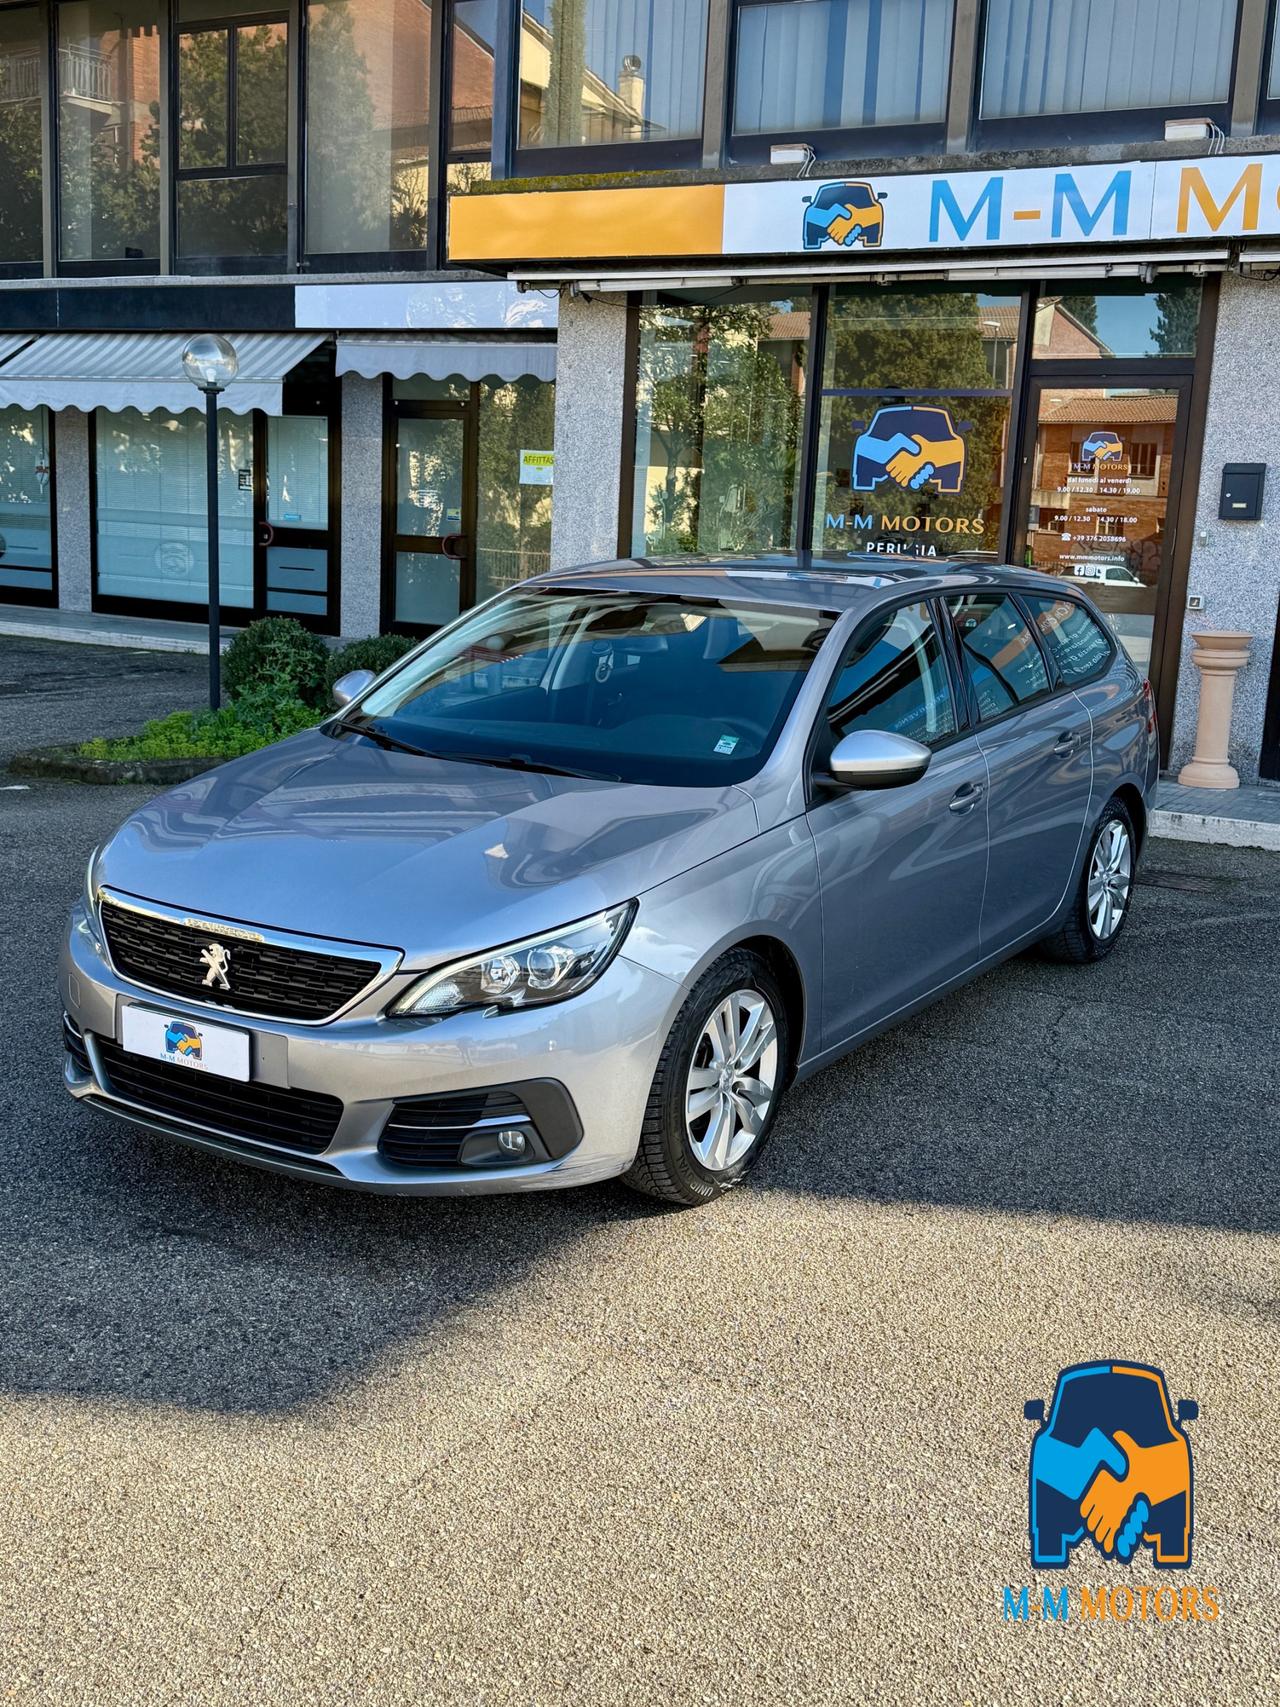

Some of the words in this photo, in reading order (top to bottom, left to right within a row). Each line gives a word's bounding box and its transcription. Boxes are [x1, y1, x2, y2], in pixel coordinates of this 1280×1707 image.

[929, 170, 1132, 243] M-M
[1176, 163, 1280, 233] M
[1093, 463, 1128, 471] MOTORS
[826, 513, 873, 529] M-M
[881, 515, 984, 535] MOTORS
